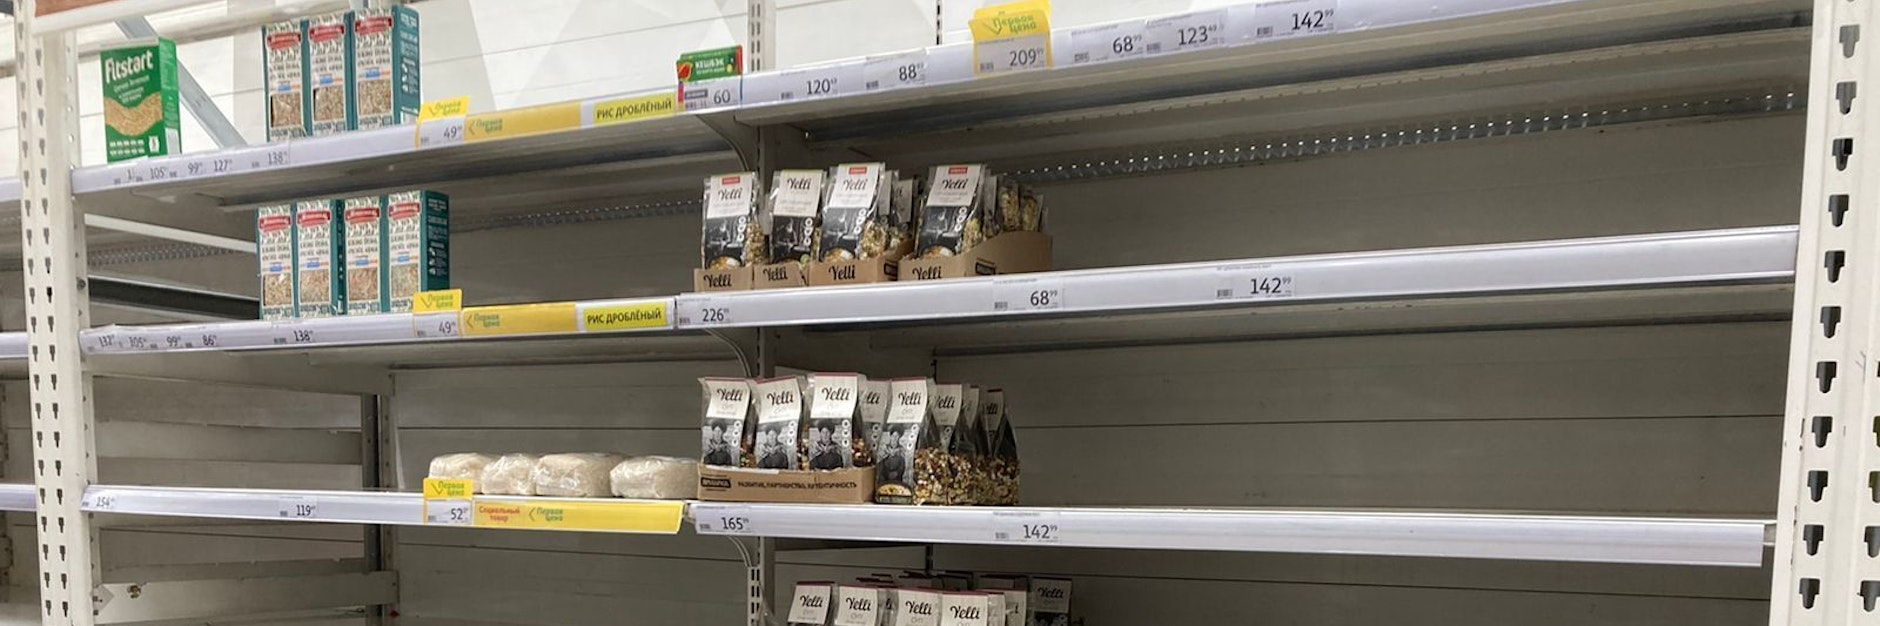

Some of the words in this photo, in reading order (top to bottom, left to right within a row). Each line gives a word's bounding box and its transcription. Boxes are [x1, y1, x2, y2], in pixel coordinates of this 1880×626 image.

[596, 107, 614, 119] РИС
[787, 177, 811, 191] Yelli
[843, 179, 868, 191] Yelli
[942, 178, 968, 190] Yelli
[718, 188, 743, 200] Yelli
[763, 267, 788, 281] Yelli
[828, 264, 856, 281] Yelli
[703, 274, 732, 288] Yelli
[587, 313, 604, 325] РИС
[717, 388, 743, 402] Yelli
[766, 392, 794, 406] Yelli
[821, 387, 850, 401] Yelli
[898, 392, 922, 406] Yelli
[1037, 586, 1064, 600] Yelli
[800, 594, 823, 608] Yelli
[845, 597, 871, 612] Yelli
[905, 600, 932, 615] Yelli
[950, 604, 981, 620] Yelli
